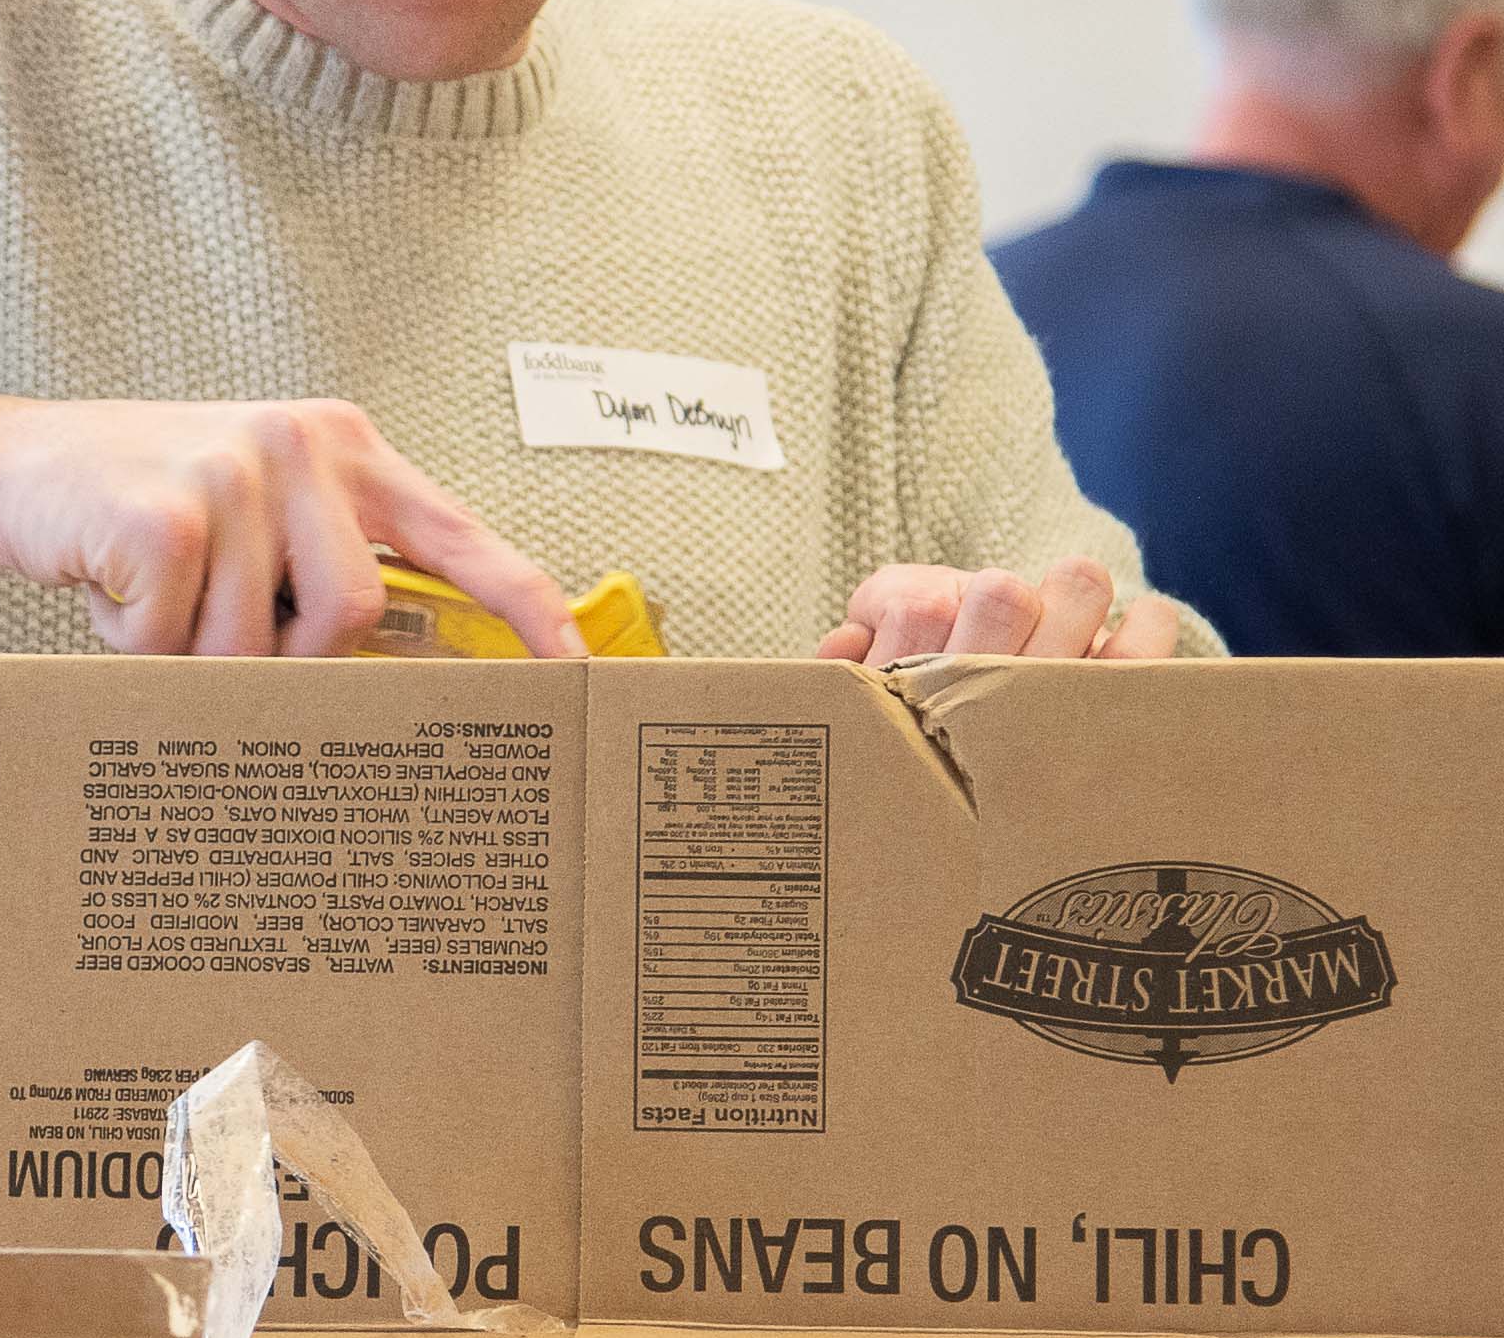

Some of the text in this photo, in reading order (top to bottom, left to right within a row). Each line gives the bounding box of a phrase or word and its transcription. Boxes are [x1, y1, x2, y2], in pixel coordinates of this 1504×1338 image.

[413, 721, 553, 739] CONTAINS:SOY.
[87, 738, 550, 760] POWDER, DEHYDRATED ONION, CUMIN SEED
[81, 781, 550, 803] SOY LECITHIN (ETHOXYLATED MONO-DIGLYCERIDES
[82, 912, 548, 934] SALT, CARAMEL COLOR), BEEF, MODIFIED FOOD
[1054, 890, 1282, 964] Classics
[76, 932, 548, 956] CRUMBLES (BEEF, WATER, TEXTURED SOY FLOUR,
[74, 953, 548, 975] INGREDIENTS: WATER, SEASONED COOKED BEEF
[982, 942, 1360, 1013] MARKET STREET
[84, 1066, 199, 1083] PER 236g SERVING
[9, 1083, 174, 1102] LOWERED FROM 970mg TO
[73, 1106, 108, 1120] 22911
[641, 1106, 816, 1126] Nutrition Facts
[29, 1124, 159, 1140] USDA CHILI, NO BEAN
[8, 1150, 164, 1200] ODIUM
[638, 1212, 1290, 1306] CHILI, NO BEANS
